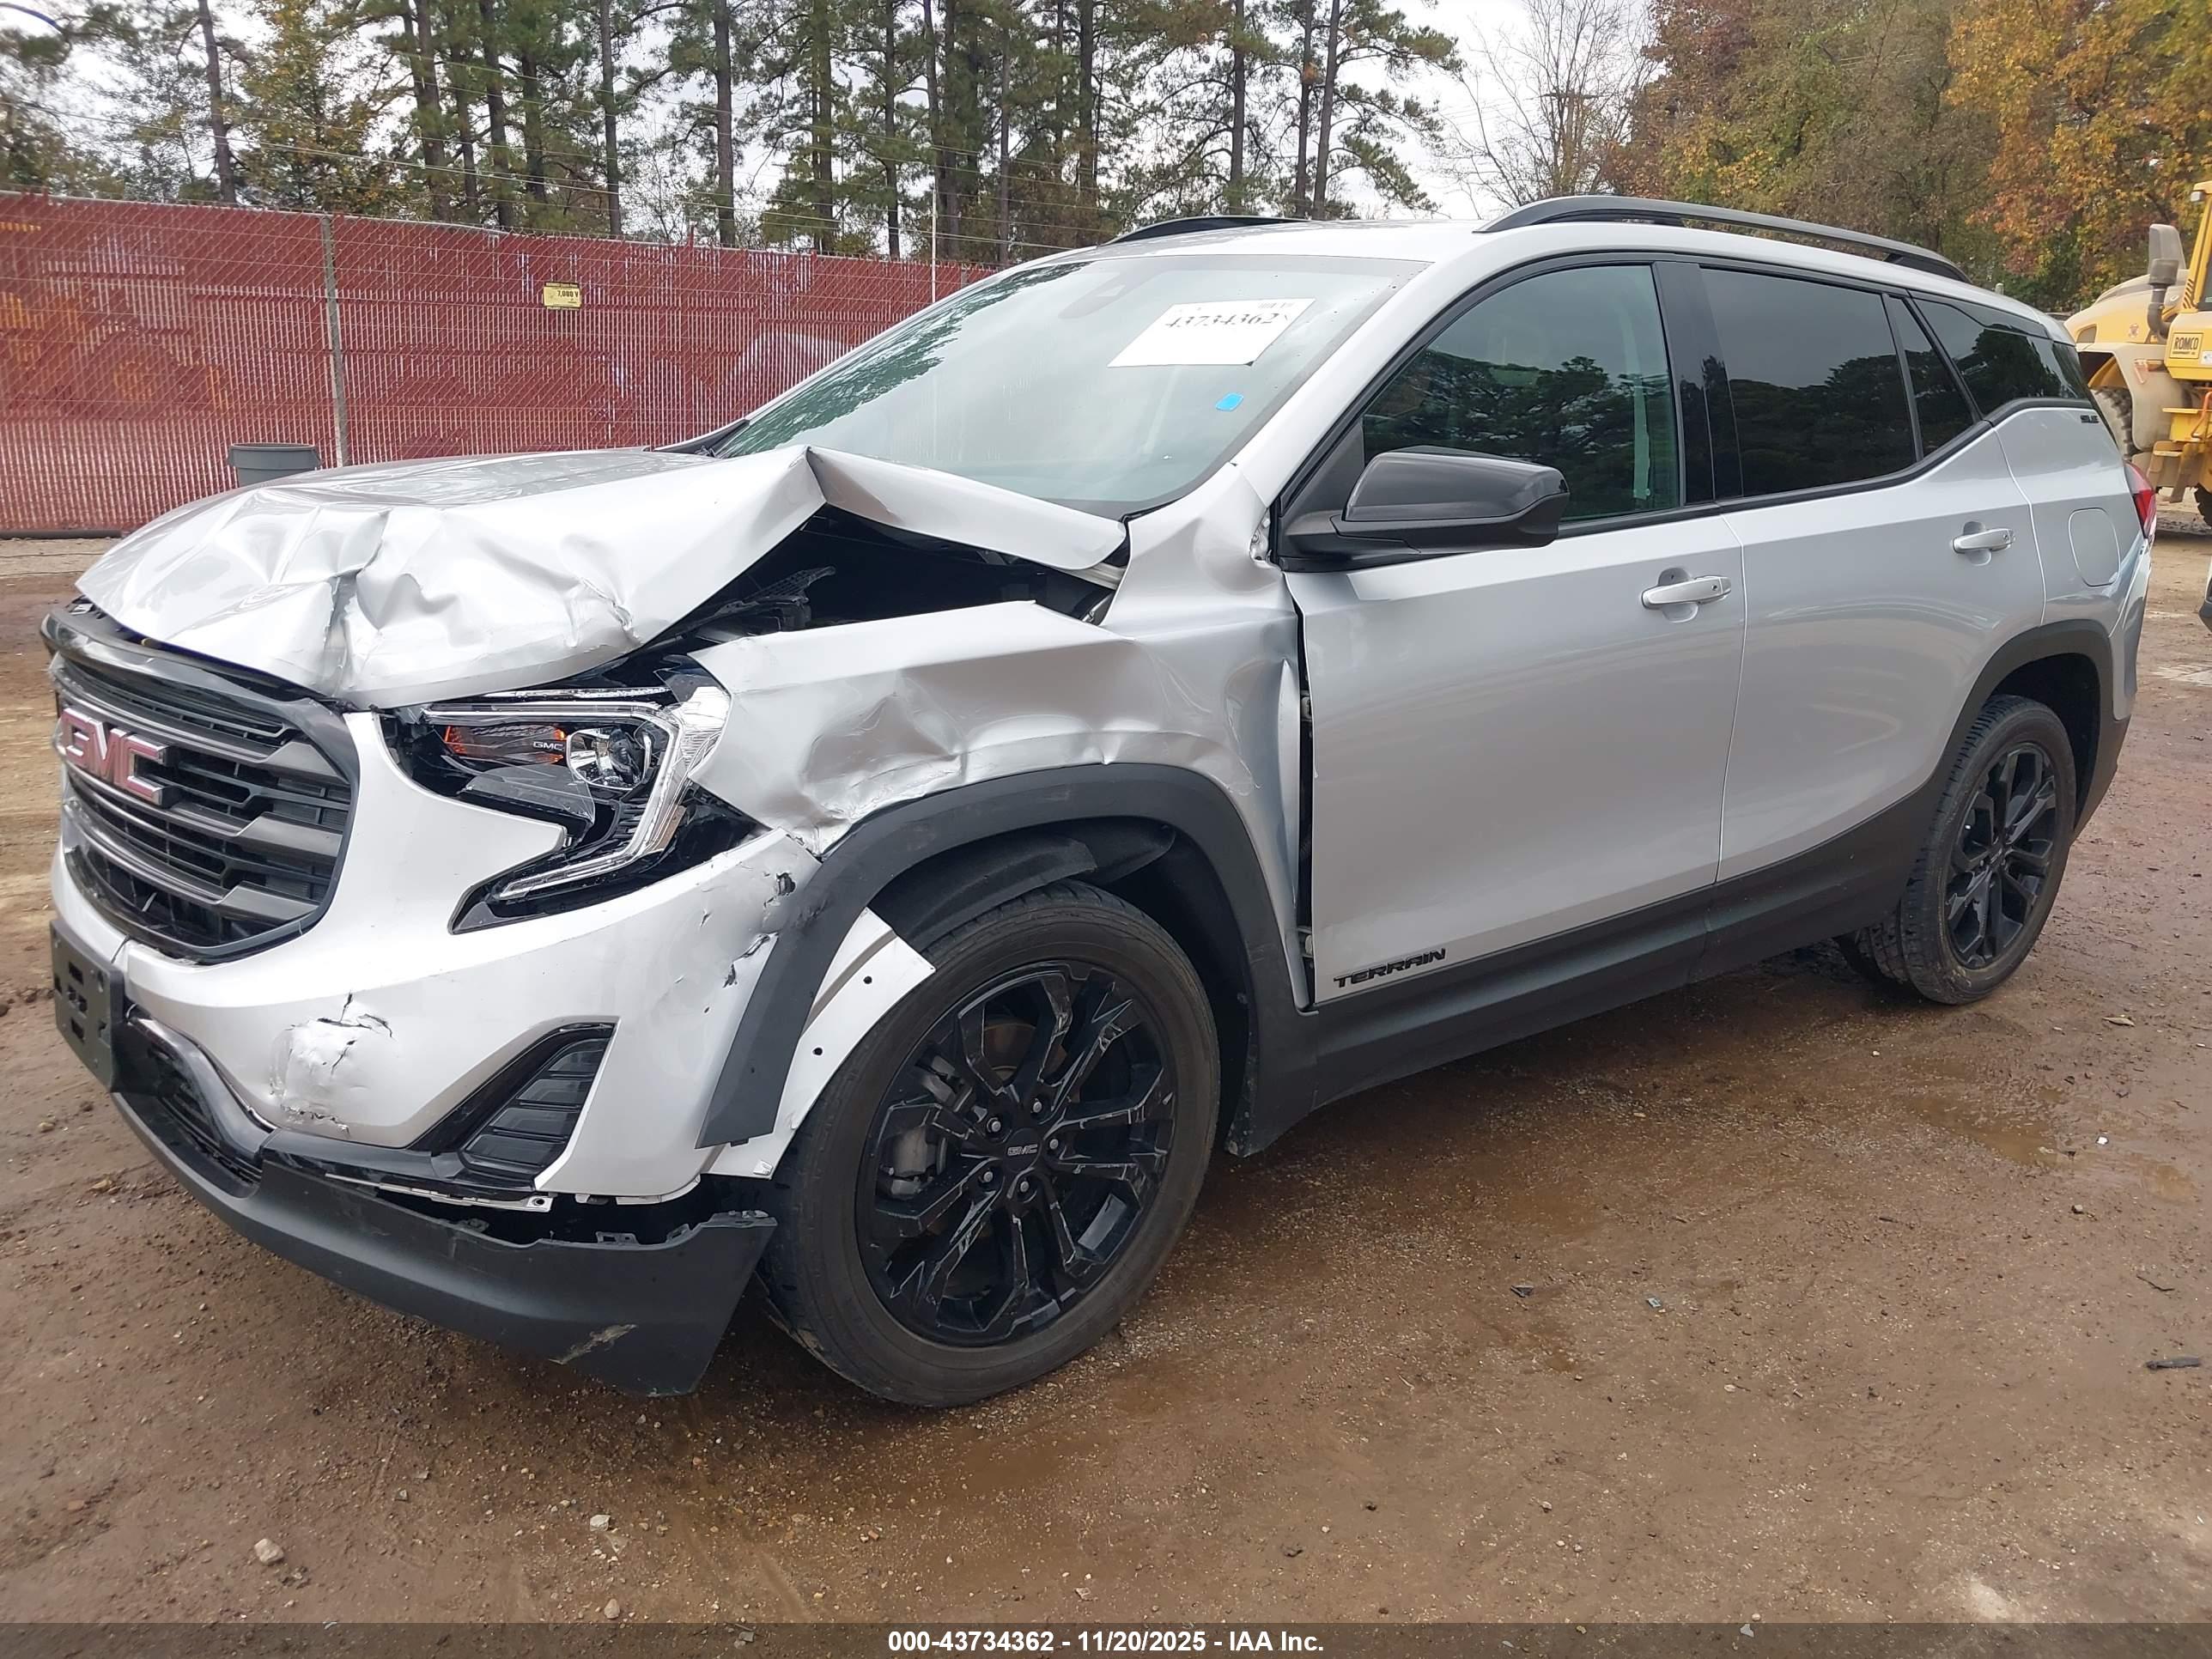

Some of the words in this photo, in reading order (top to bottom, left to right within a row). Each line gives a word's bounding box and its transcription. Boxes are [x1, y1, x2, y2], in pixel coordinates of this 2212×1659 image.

[557, 289, 574, 298] 7,000
[1164, 312, 1280, 329] 43734362
[2172, 337, 2200, 350] ROMCO
[532, 741, 564, 751] GMC
[59, 708, 169, 806] GMC
[1334, 948, 1446, 988] TERRAIN
[1007, 1144, 1038, 1156] GMC
